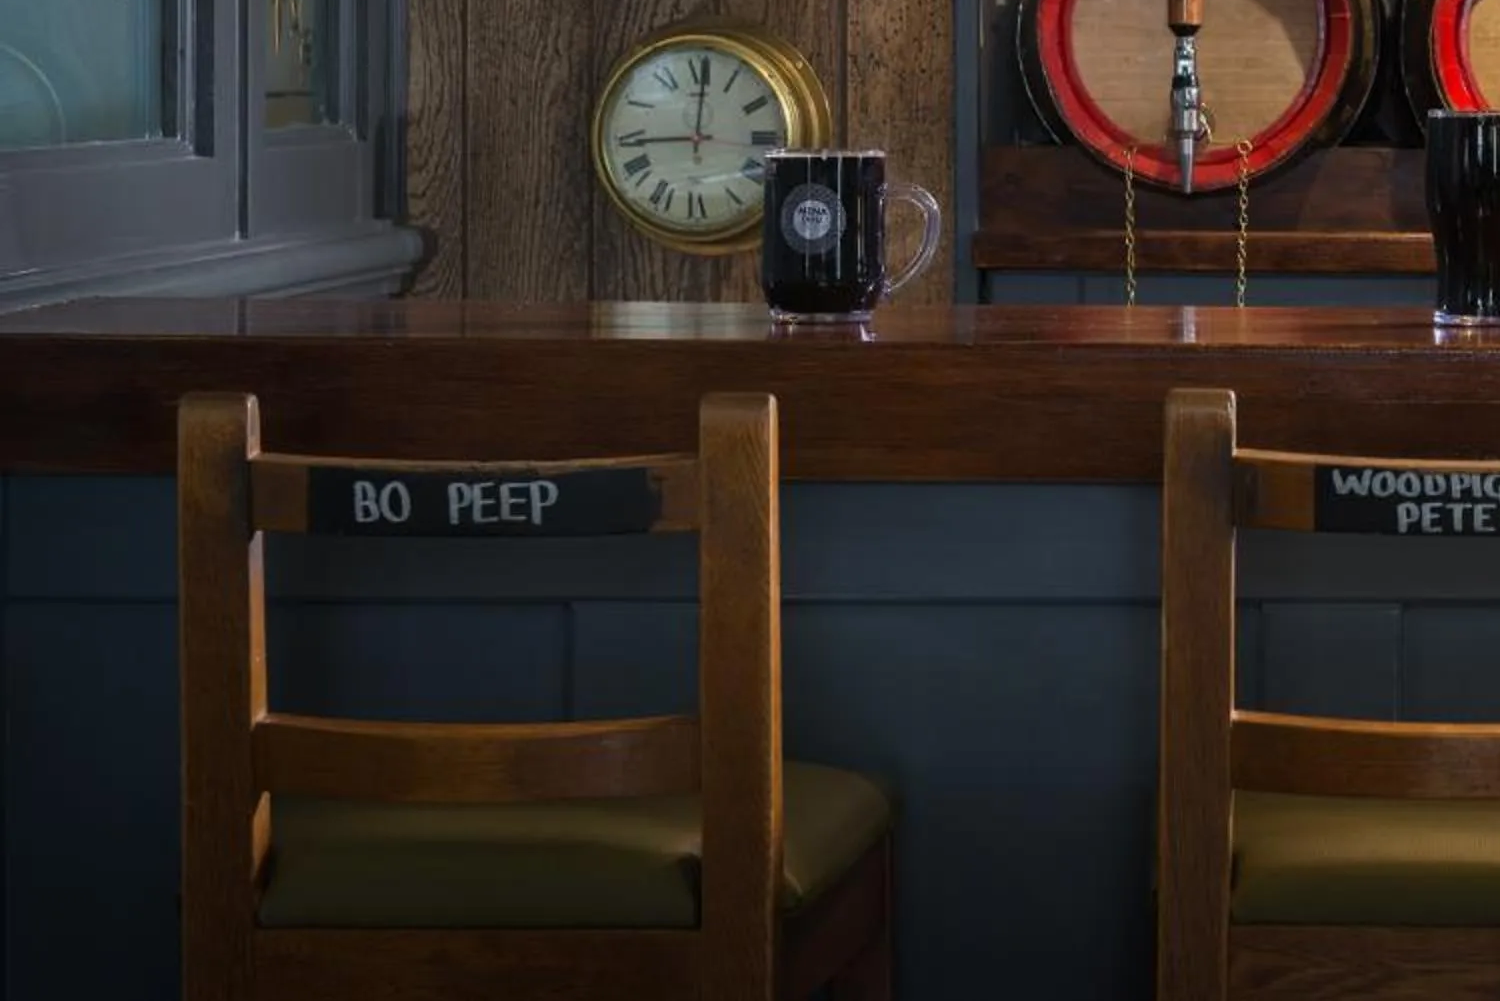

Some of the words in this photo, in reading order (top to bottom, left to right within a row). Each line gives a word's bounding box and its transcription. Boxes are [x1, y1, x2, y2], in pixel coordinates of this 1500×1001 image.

[353, 480, 411, 522] BO
[448, 480, 559, 525] PEEP
[1396, 502, 1497, 534] PETE
